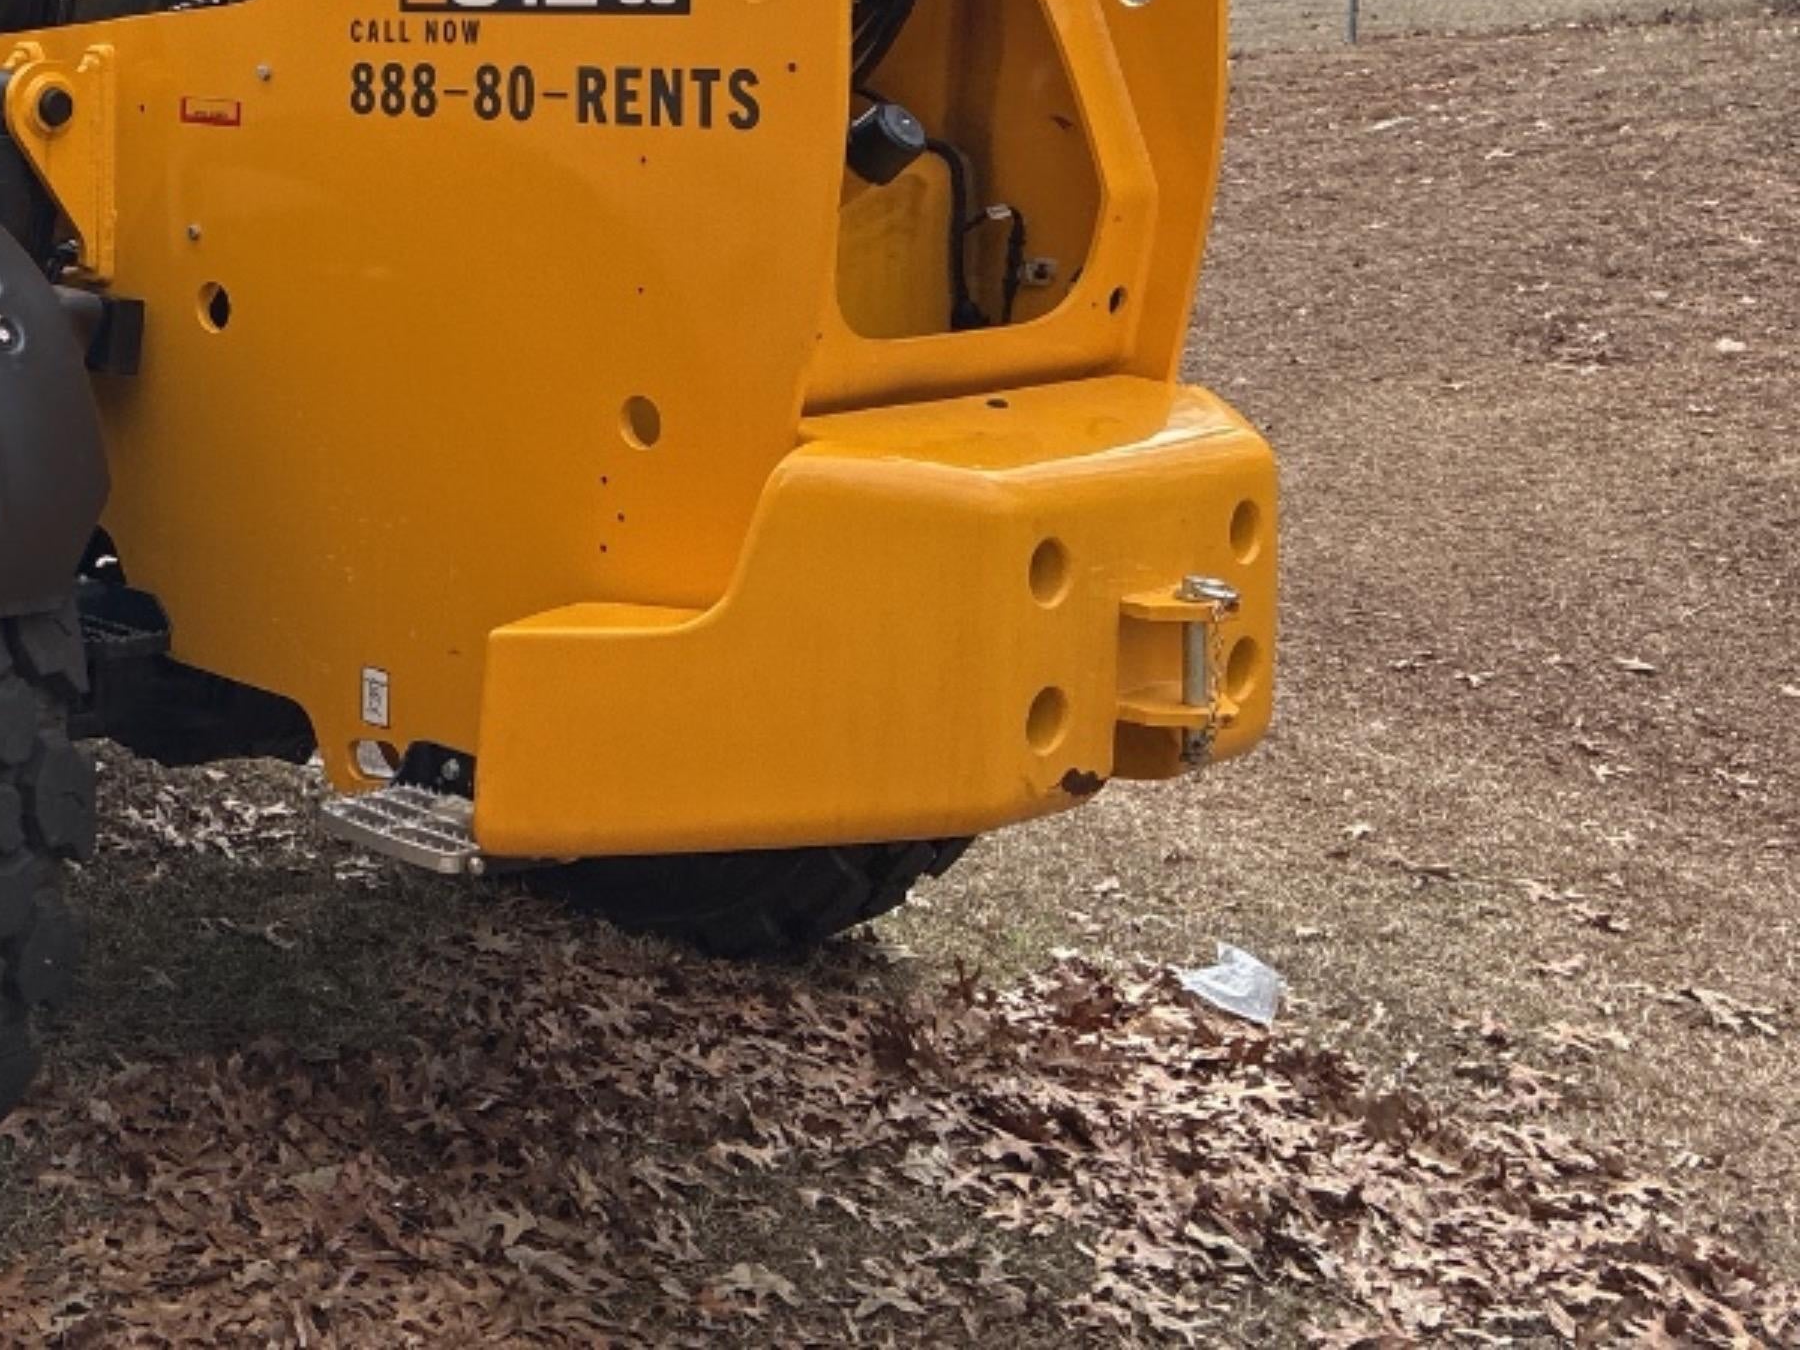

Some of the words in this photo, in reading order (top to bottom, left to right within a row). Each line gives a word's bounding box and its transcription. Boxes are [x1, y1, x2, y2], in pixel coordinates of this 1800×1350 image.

[350, 19, 411, 43] CALL
[425, 20, 480, 43] NOW
[350, 61, 760, 131] 888-80-RENTS
